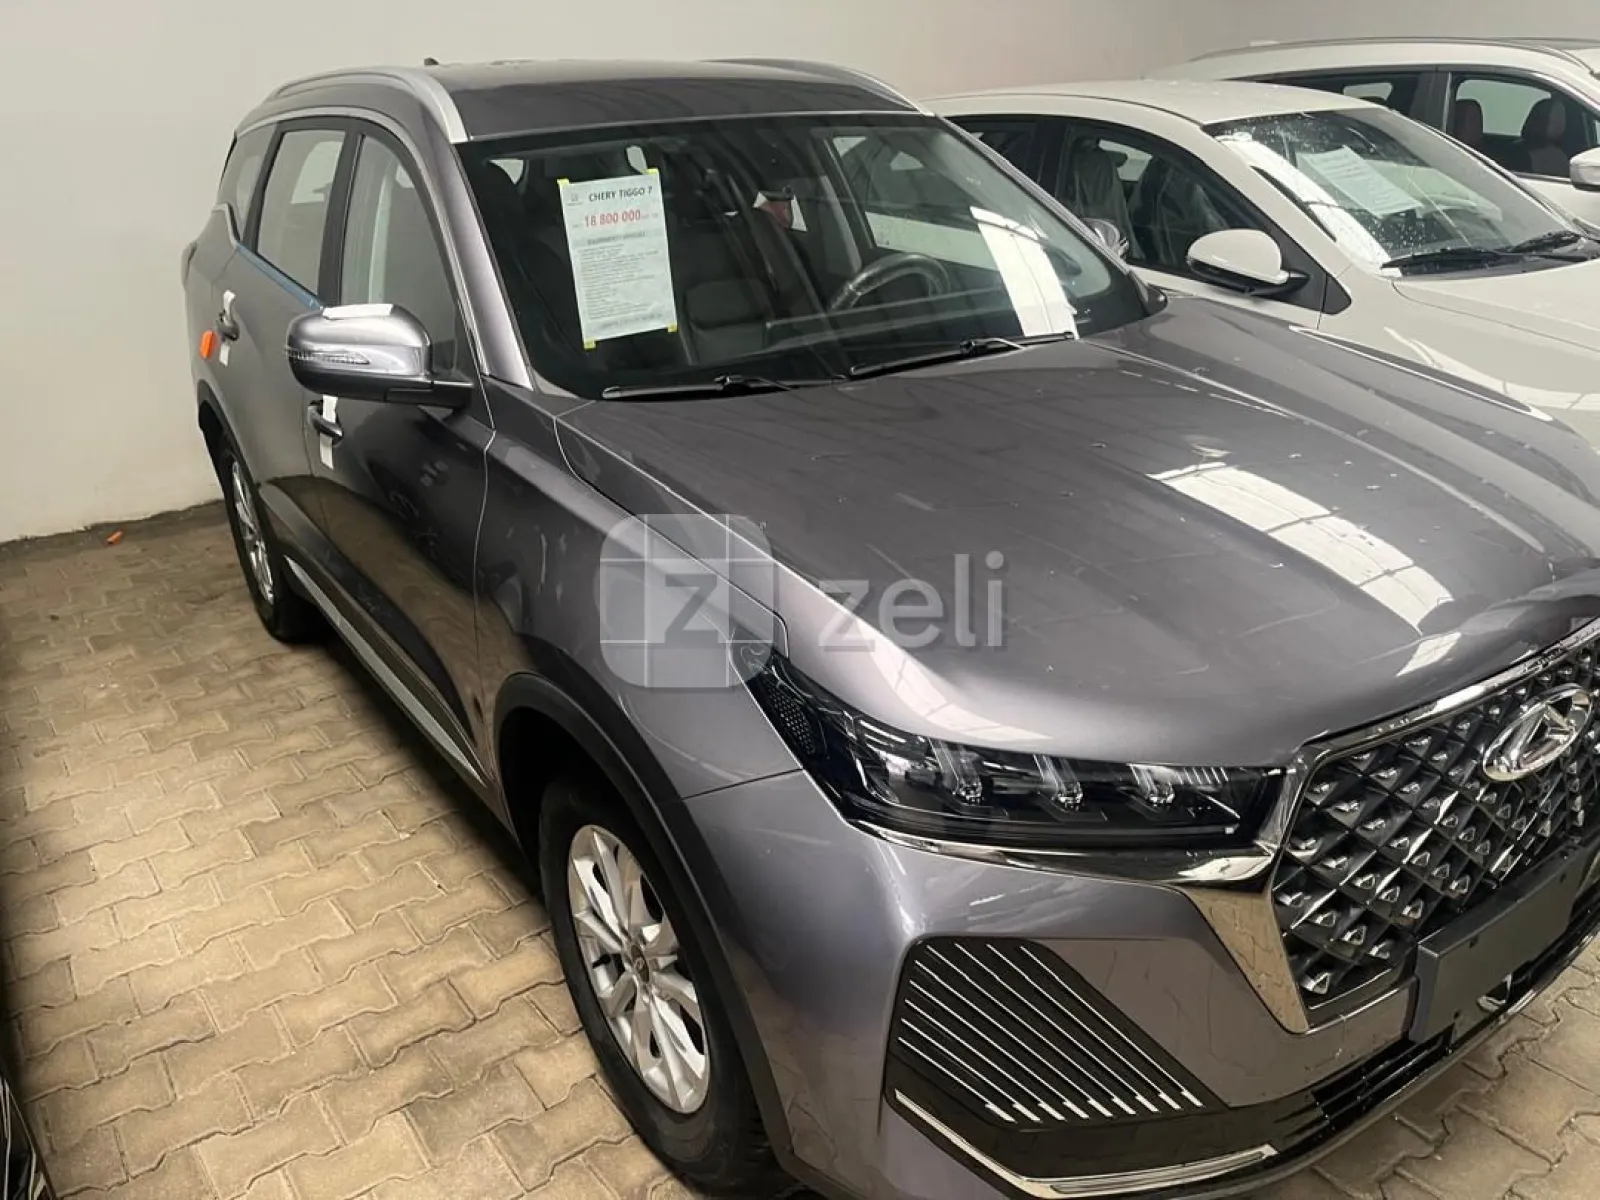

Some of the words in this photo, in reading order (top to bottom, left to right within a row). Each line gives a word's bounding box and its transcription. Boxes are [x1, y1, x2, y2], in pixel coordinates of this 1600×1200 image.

[588, 190, 617, 202] CHERY
[619, 188, 645, 200] TIGGO
[646, 186, 653, 195] 7
[622, 209, 641, 222] 000
